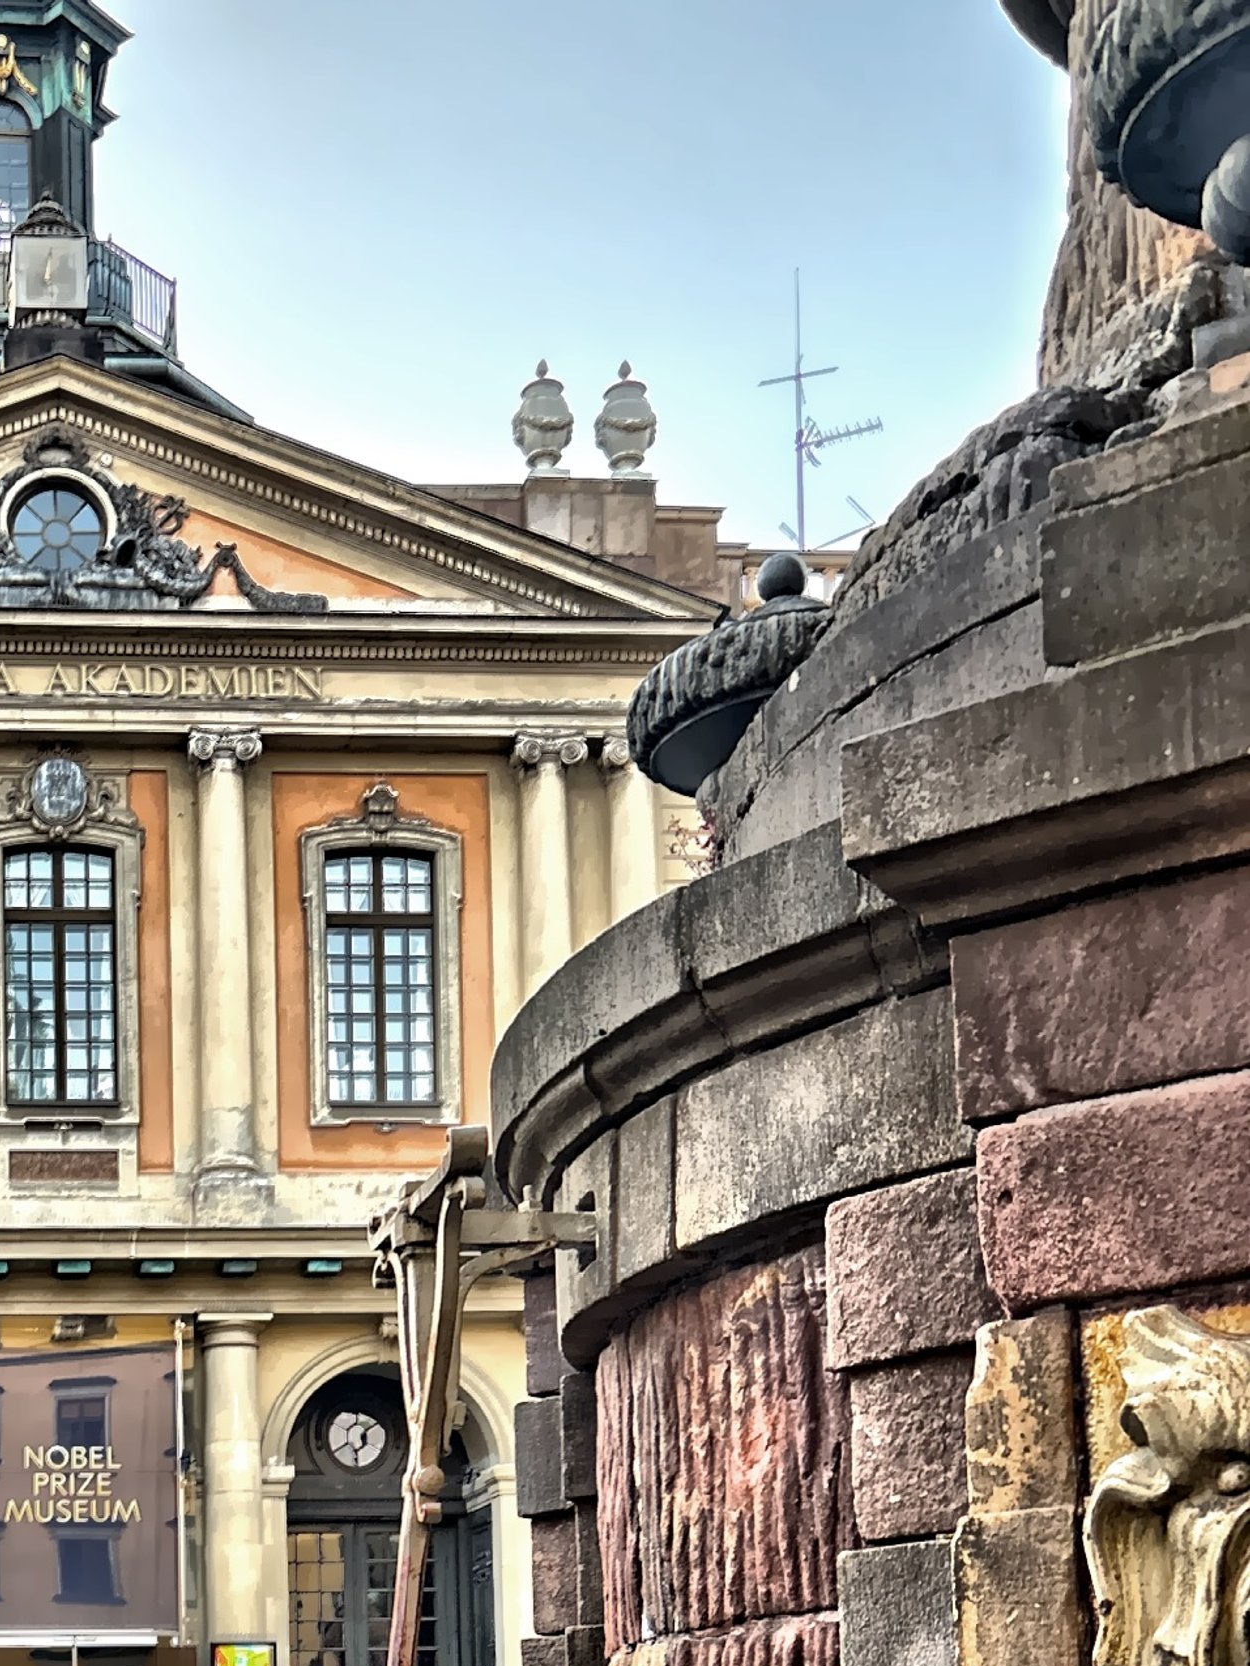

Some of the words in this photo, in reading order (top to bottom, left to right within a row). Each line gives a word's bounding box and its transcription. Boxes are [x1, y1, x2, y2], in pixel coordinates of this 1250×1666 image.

[43, 662, 325, 698] AKADEMIEN
[23, 1444, 123, 1470] NOBEL
[32, 1471, 113, 1497] PRIZE
[3, 1498, 143, 1523] MUSEUM
